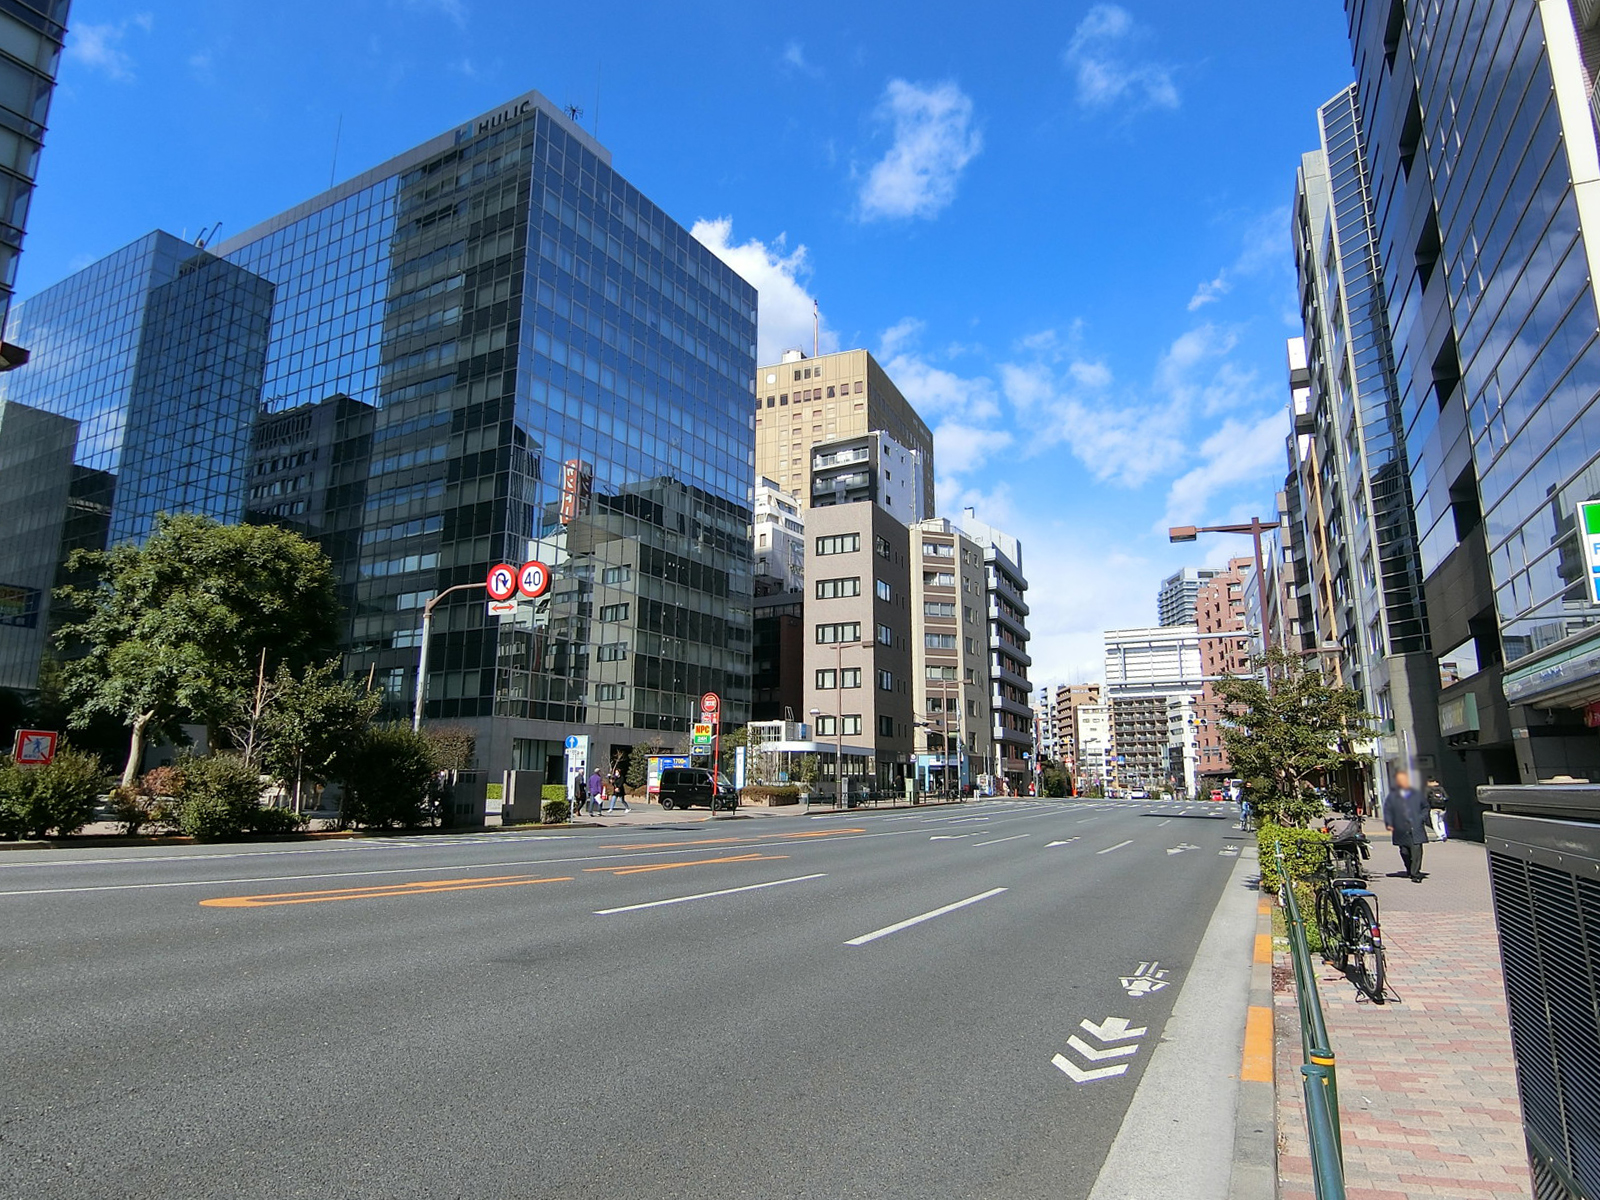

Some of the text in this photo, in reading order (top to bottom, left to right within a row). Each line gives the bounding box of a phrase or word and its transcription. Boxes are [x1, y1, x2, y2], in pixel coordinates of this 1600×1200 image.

[478, 100, 530, 134] HULIC
[524, 571, 541, 587] 40
[695, 725, 710, 734] NPC
